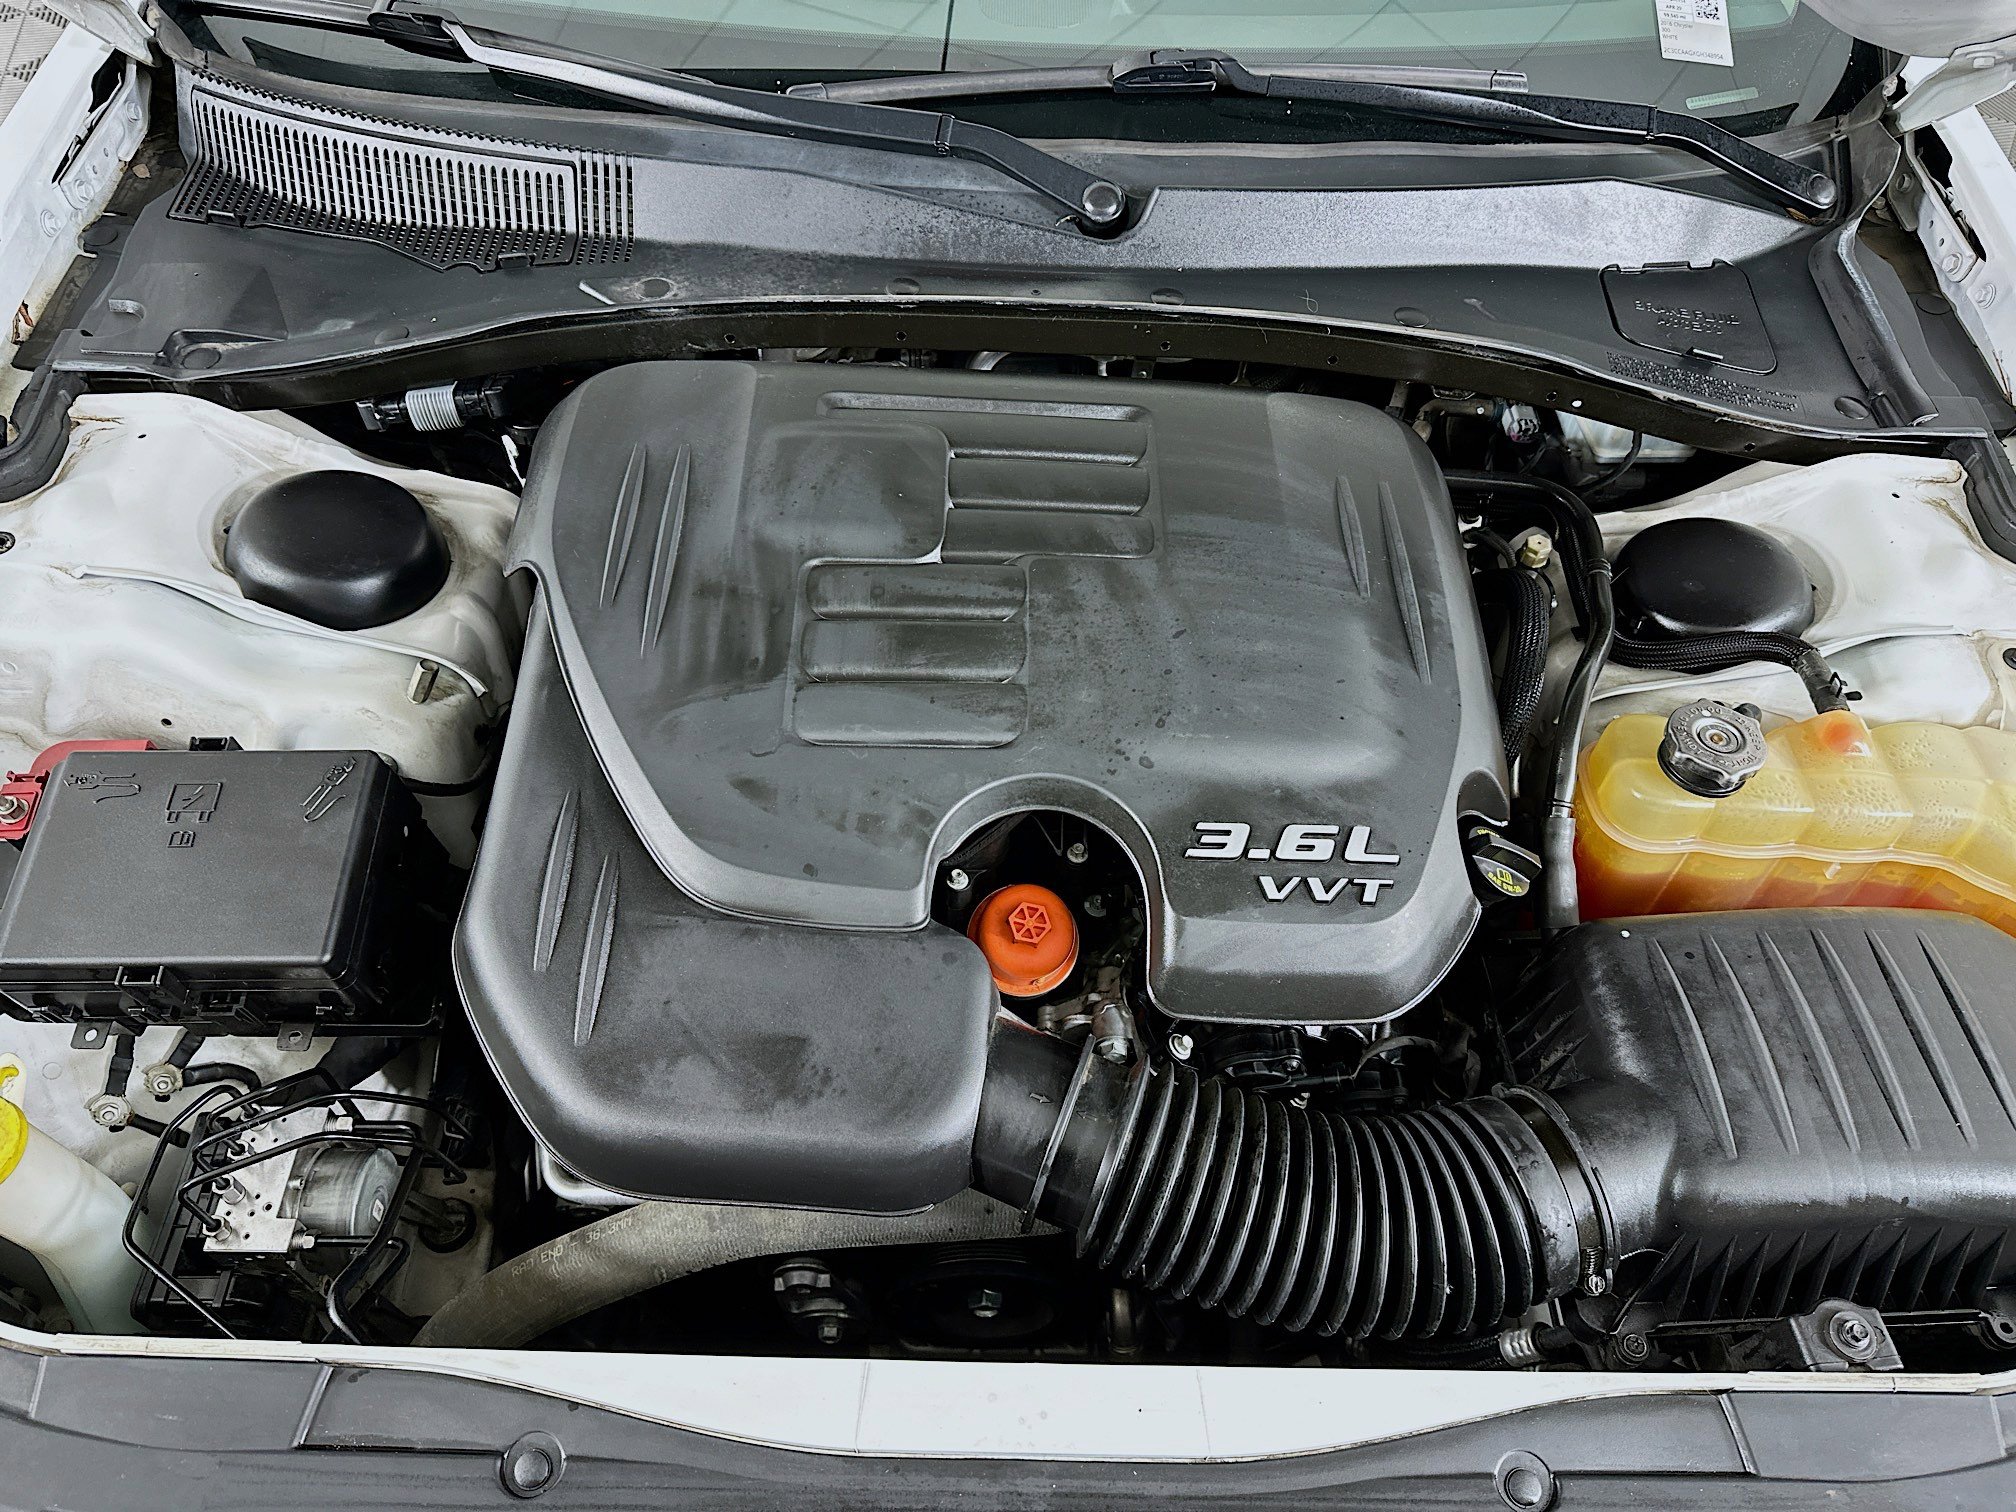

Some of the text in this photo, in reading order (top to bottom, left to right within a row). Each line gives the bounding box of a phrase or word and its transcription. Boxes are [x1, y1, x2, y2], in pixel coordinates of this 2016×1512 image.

[1184, 822, 1400, 865] 3.6L
[1258, 875, 1394, 907] VVT
[540, 1244, 564, 1264] END
